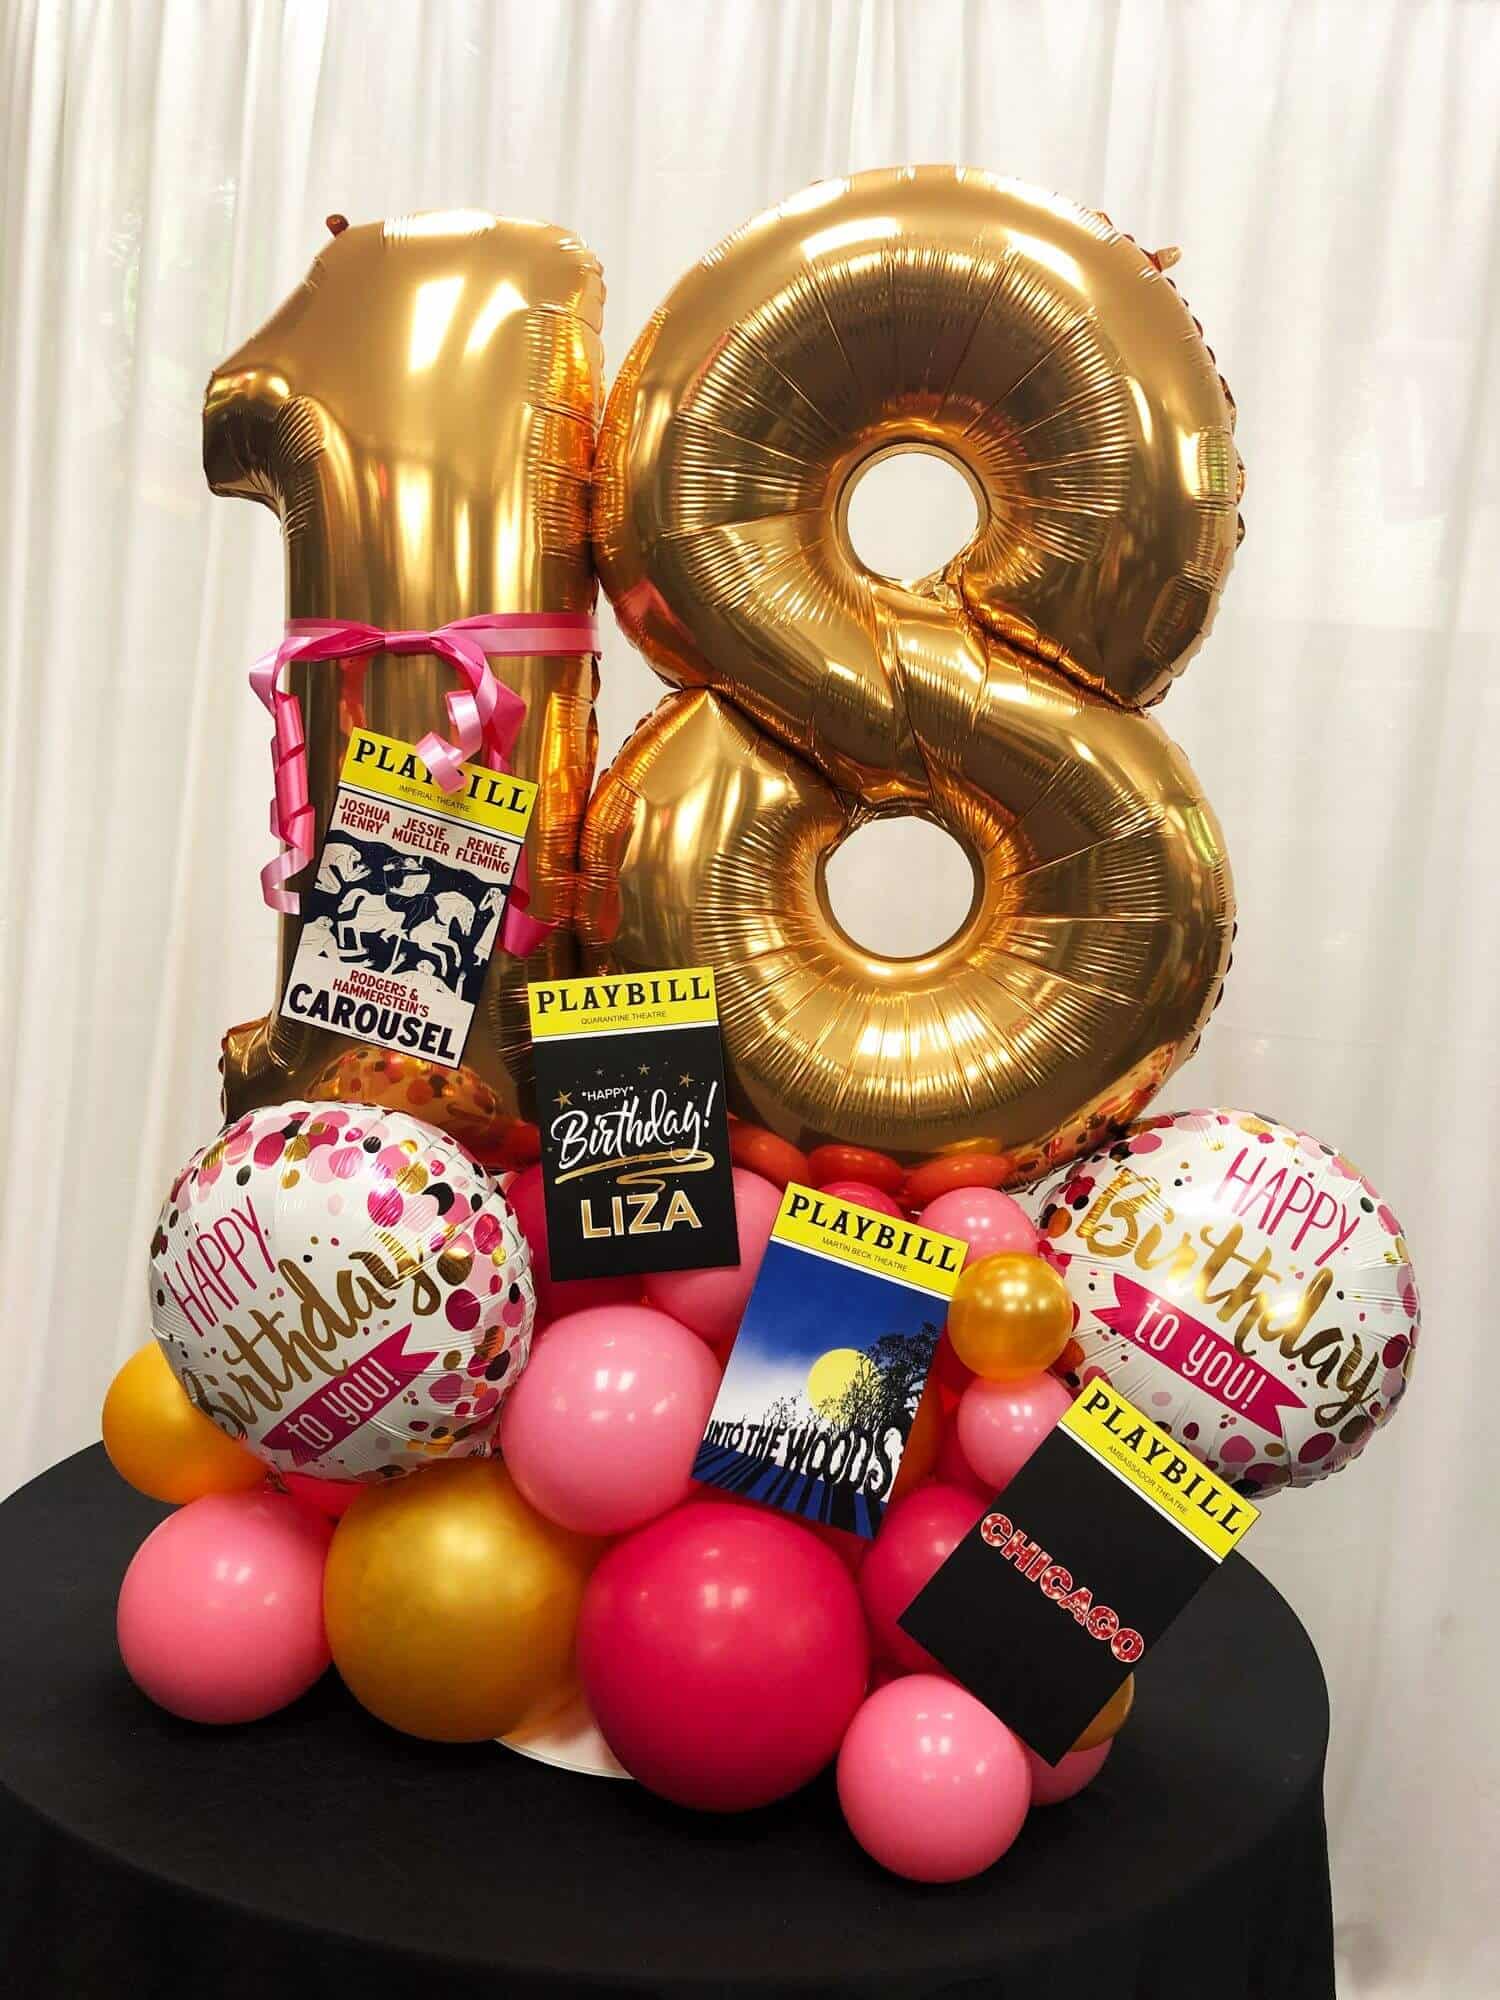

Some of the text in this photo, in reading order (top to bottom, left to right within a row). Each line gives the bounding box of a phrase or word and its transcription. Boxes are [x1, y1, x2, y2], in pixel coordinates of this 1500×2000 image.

[352, 738, 528, 814] PLAILL
[398, 783, 473, 813] IMPERIAL THEATRE
[339, 797, 391, 824] JOSHUA
[340, 811, 385, 835] HENRY
[401, 817, 447, 841] JESSIE
[391, 828, 450, 856] MUELLER
[455, 847, 511, 874] FLEMING
[466, 836, 508, 860] RENÉE
[332, 978, 431, 1018] HAMMERSTEIN'S
[349, 969, 419, 1002] RODGERS &
[536, 976, 711, 1015] PLAYBILL
[288, 982, 457, 1061] CAROUSEL
[580, 1009, 667, 1026] QUARANTINE THEATRE
[550, 1080, 718, 1170] Birthday!
[580, 1189, 703, 1239] LIZA
[1212, 1146, 1361, 1267] HAPPY
[786, 1193, 959, 1272] PLAYBILL
[820, 1235, 908, 1273] MARTIN BECK THEATRE
[163, 1195, 276, 1338] HAPPY
[1073, 1166, 1381, 1429] Birthday
[703, 1419, 898, 1501] INTO THE WOODS
[1082, 1389, 1244, 1535] PLAYBILL
[1107, 1445, 1188, 1514] AMBASSADOR THEATRE
[980, 1512, 1145, 1663] CHICAGO
